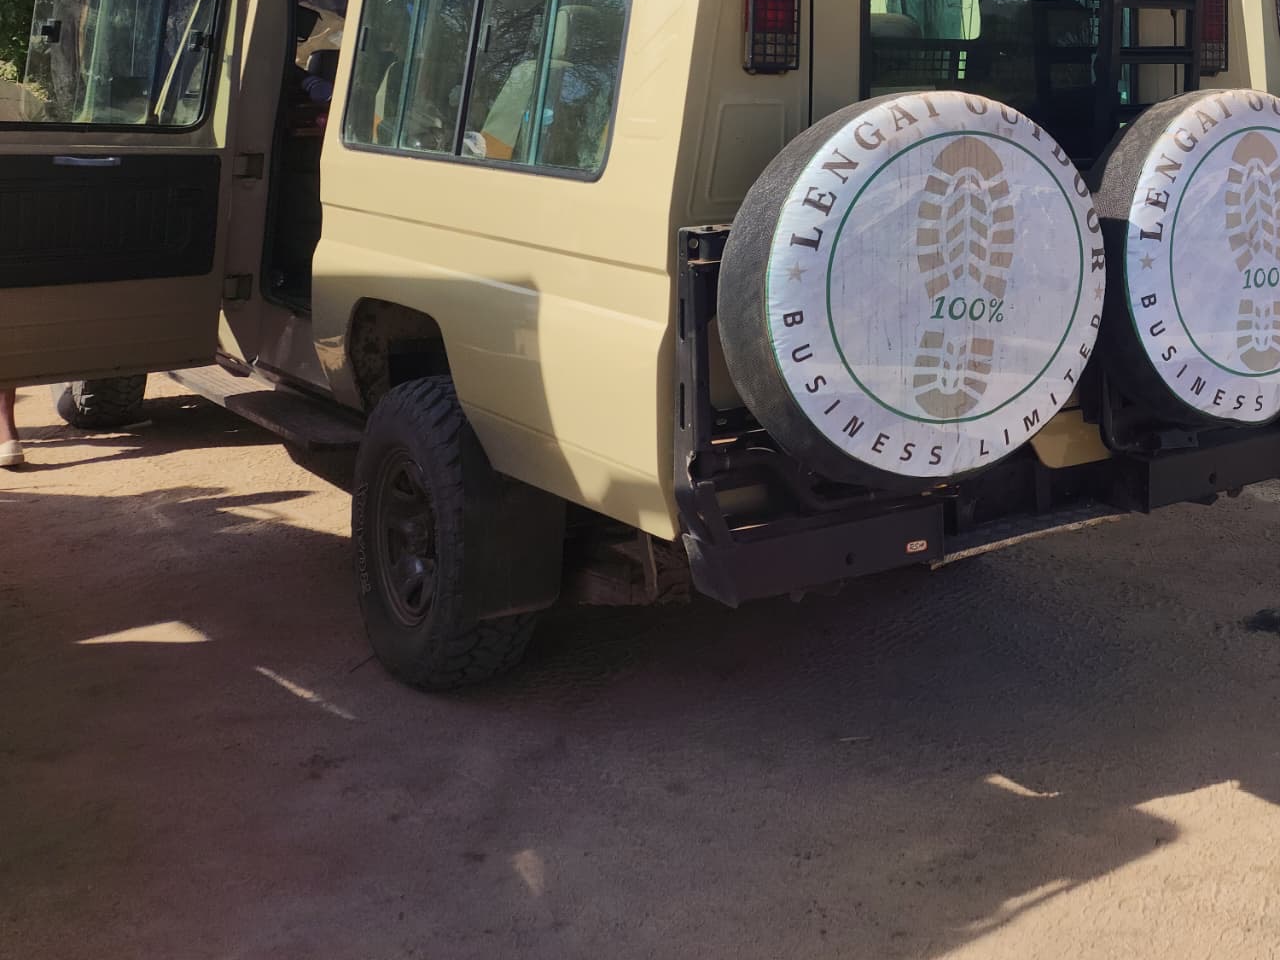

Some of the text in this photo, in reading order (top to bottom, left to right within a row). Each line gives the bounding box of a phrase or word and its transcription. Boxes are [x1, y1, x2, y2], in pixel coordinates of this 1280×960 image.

[789, 94, 940, 252] LENGAI
[1140, 96, 1232, 242] LENGAI
[930, 295, 1004, 323] 100%
[1141, 293, 1263, 411] BUSINESS
[783, 310, 1102, 465] BUSINESS LIMITED
